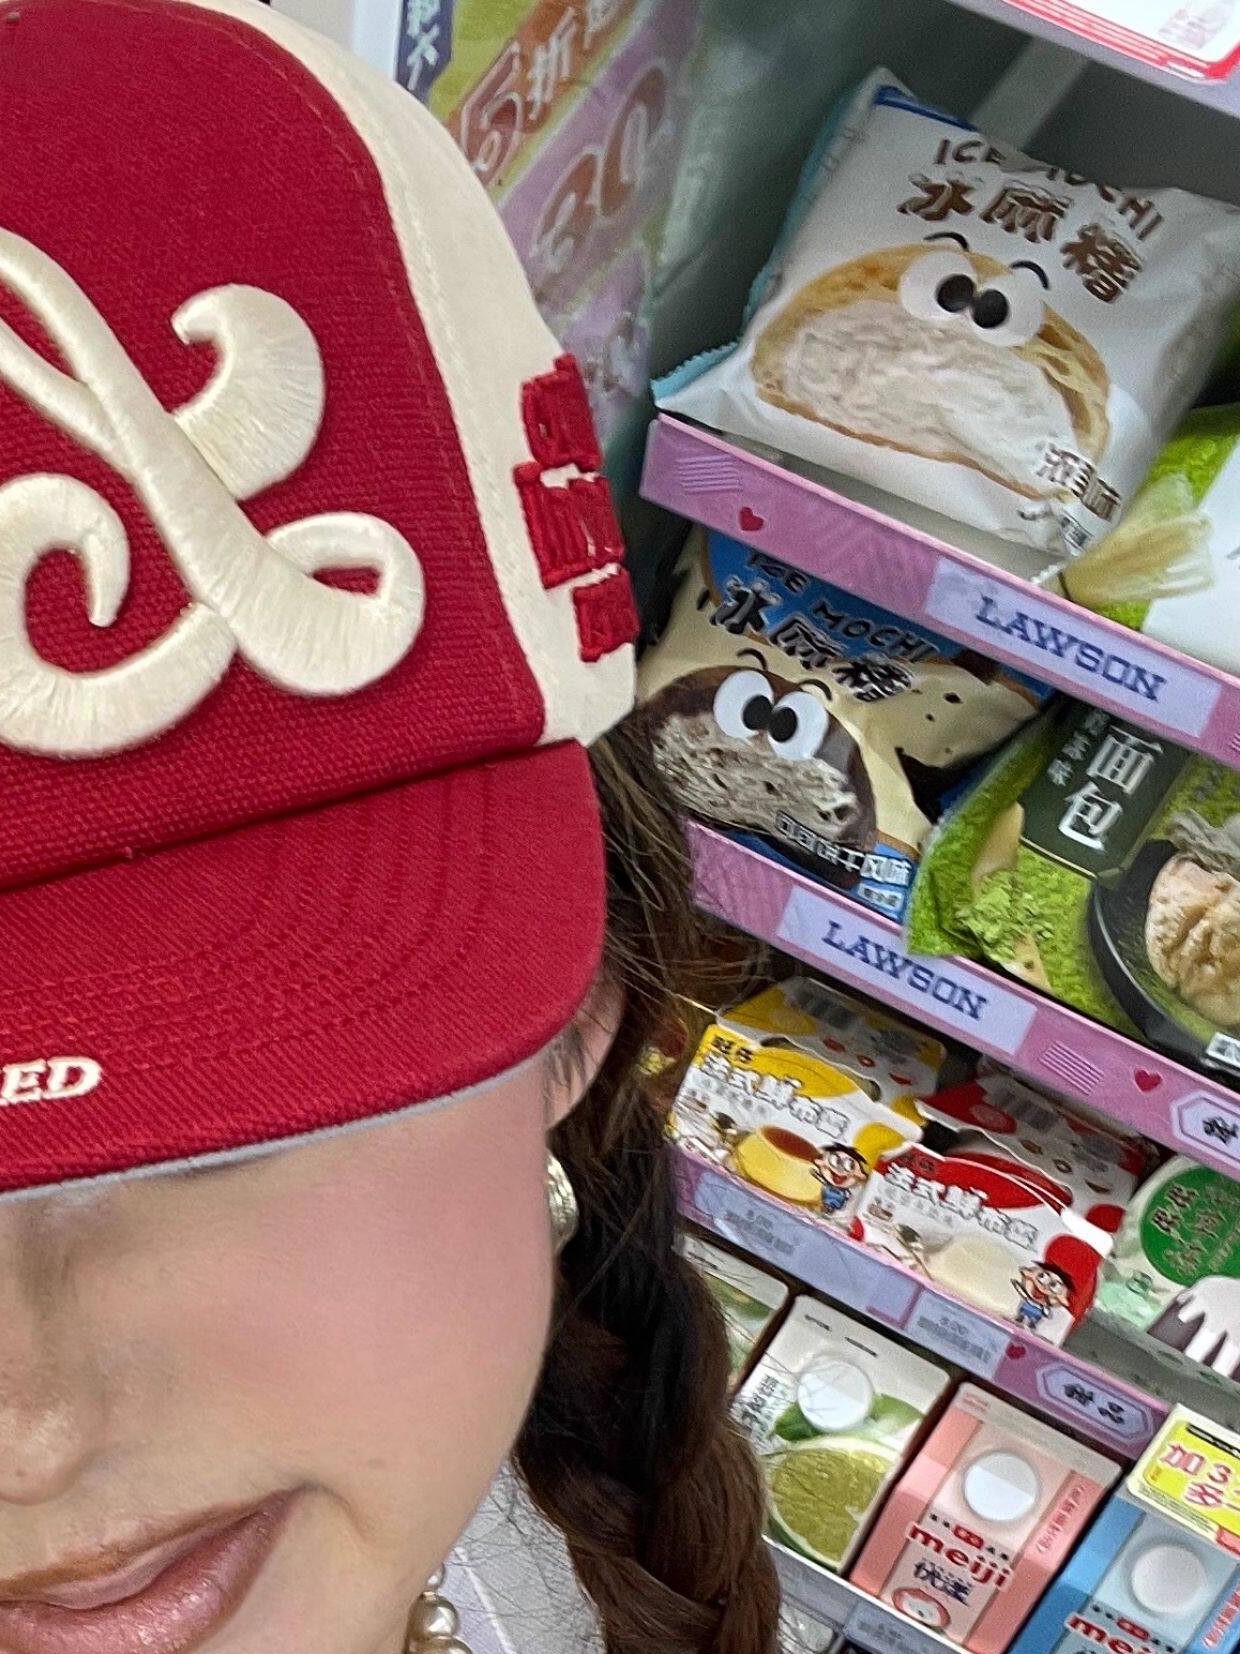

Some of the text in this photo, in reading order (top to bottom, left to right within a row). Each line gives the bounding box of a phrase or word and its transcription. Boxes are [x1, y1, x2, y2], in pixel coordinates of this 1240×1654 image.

[974, 595, 1167, 703] LAWSON
[1058, 724, 1164, 854] 面包
[821, 919, 988, 1022] LAWSON
[1160, 1442, 1240, 1486] 加3
[909, 1524, 1011, 1588] meiji
